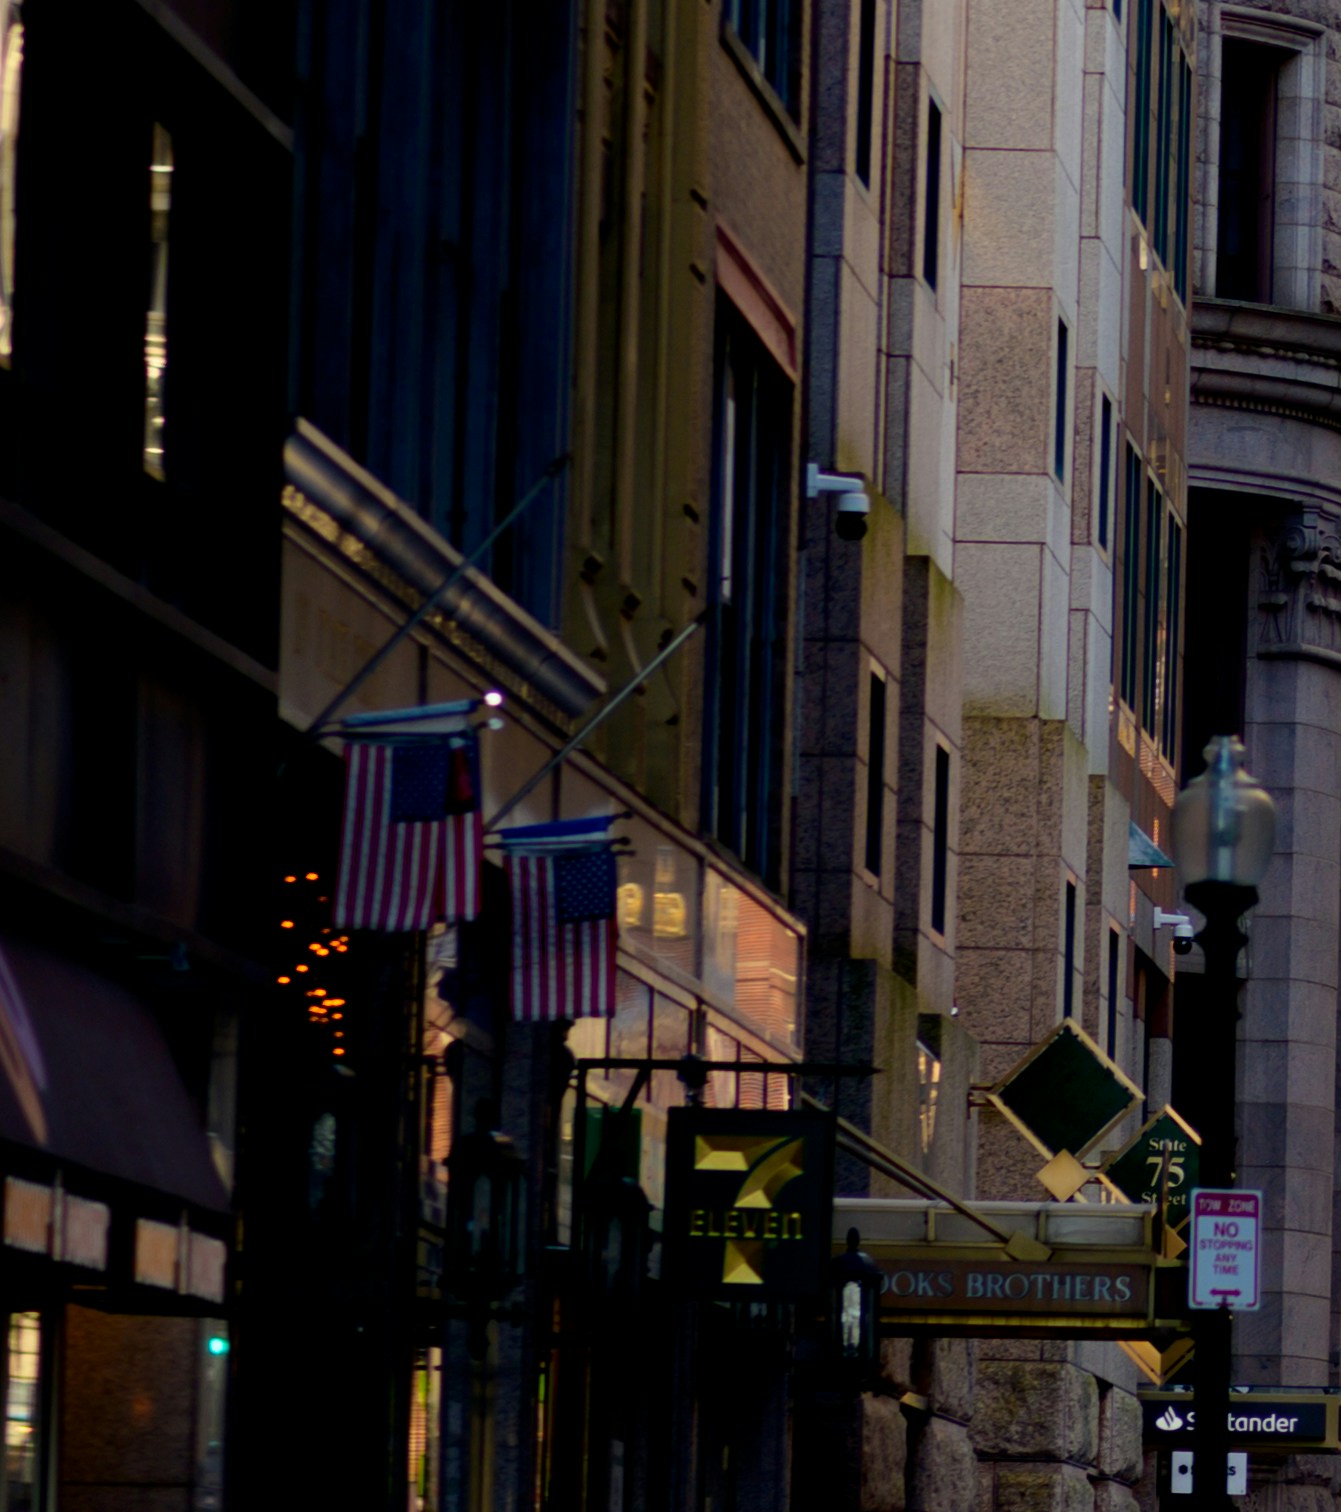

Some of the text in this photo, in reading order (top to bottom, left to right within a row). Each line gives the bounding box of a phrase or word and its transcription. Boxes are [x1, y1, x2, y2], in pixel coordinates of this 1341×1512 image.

[1145, 1155, 1186, 1188] 75
[1140, 1191, 1187, 1206] Steet
[1198, 1198, 1256, 1214] TOW ZONE
[693, 1133, 806, 1285] 7
[1213, 1222, 1239, 1239] NO
[1199, 1239, 1253, 1251] STOPPING
[1214, 1253, 1237, 1263] ANY
[1213, 1264, 1239, 1275] TIME
[966, 1272, 1132, 1302] BROTHERS
[1186, 1411, 1298, 1433] Stander
